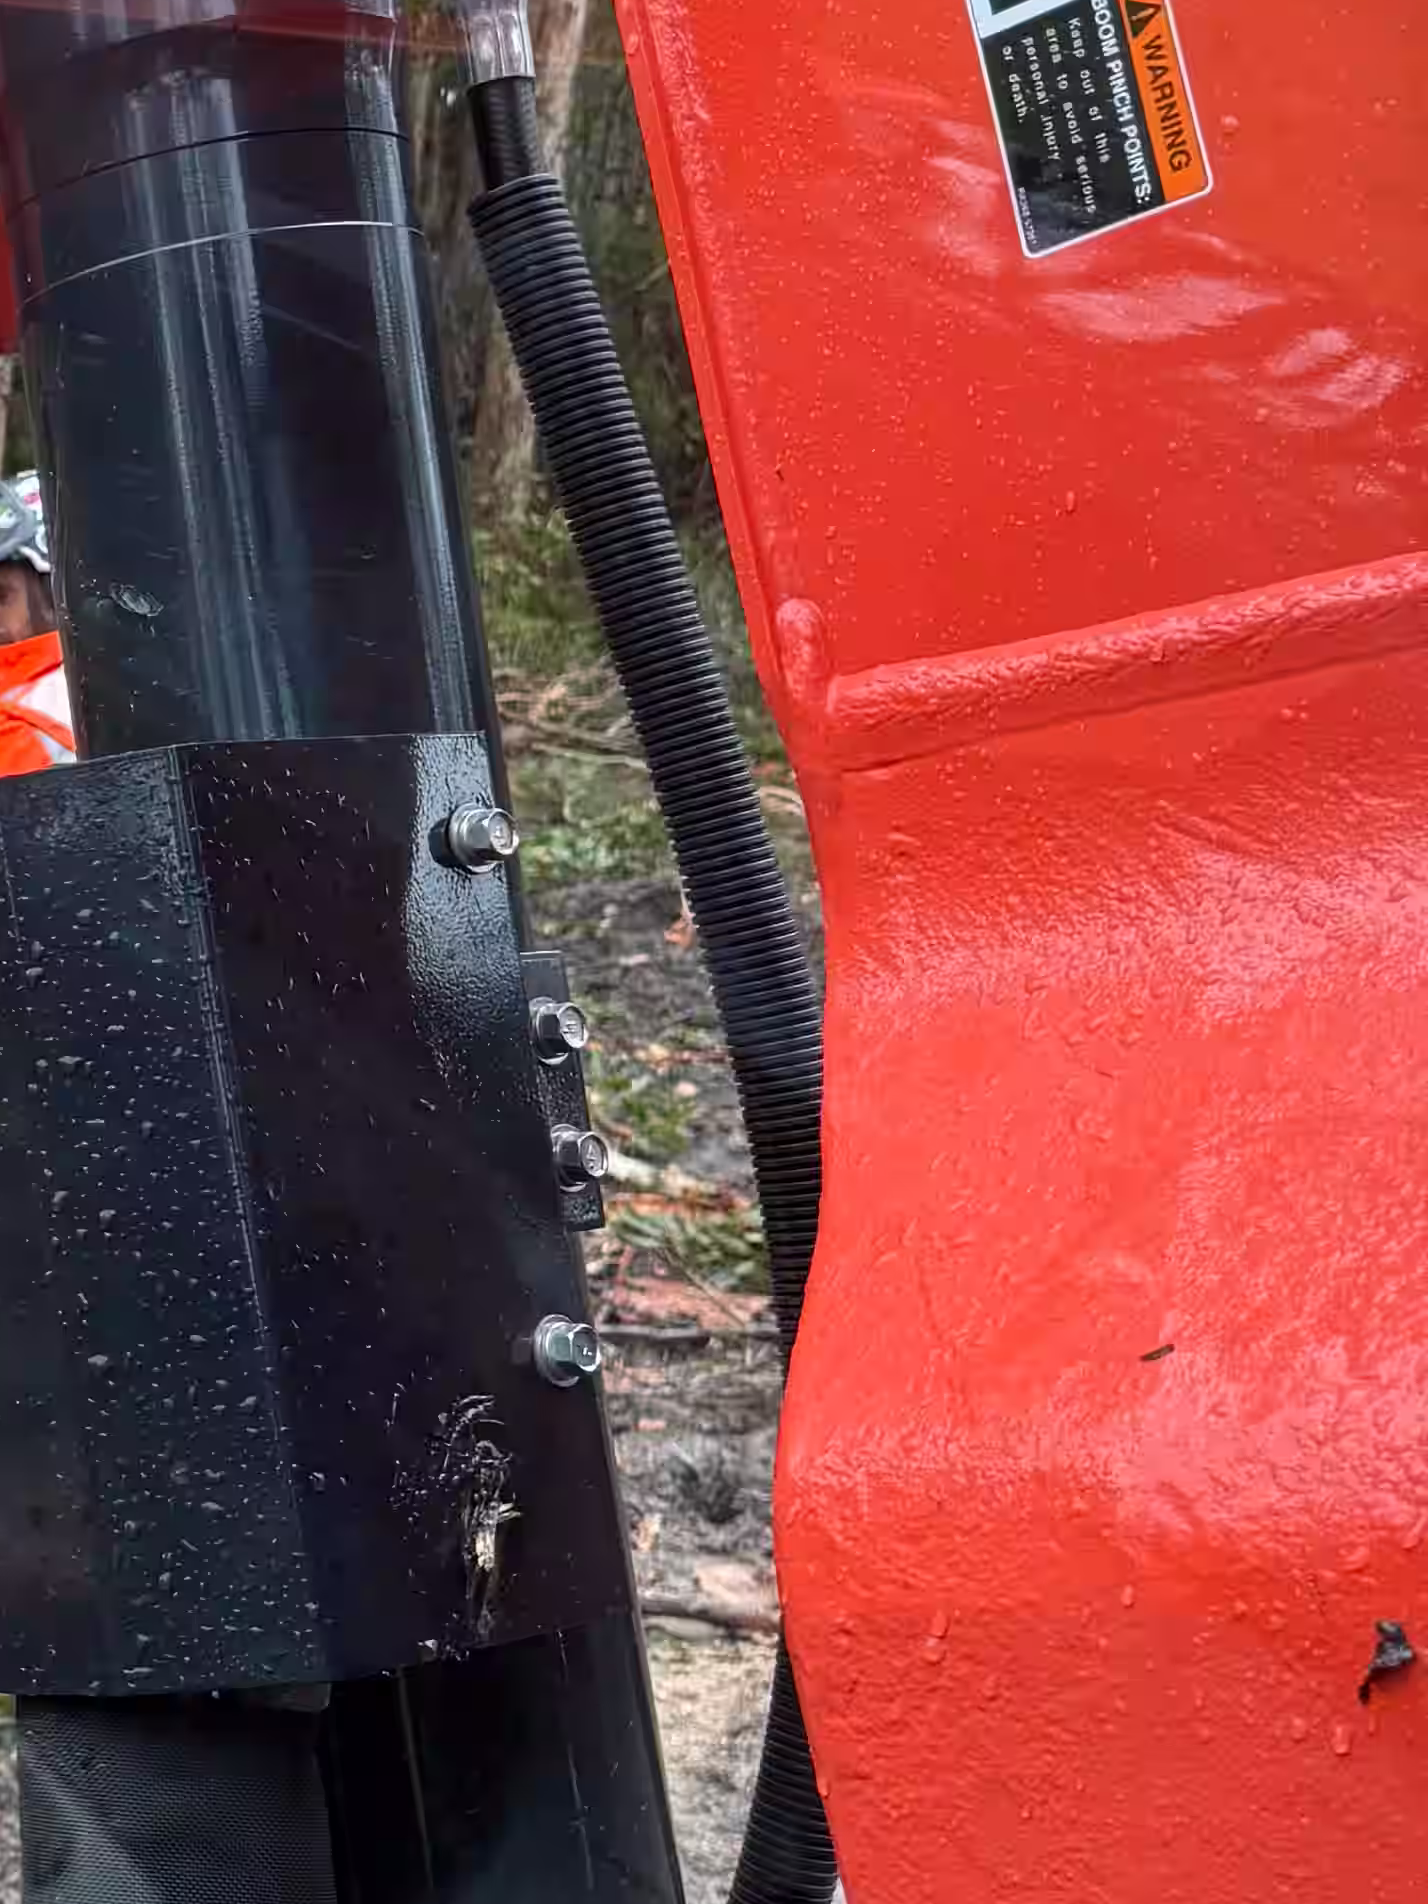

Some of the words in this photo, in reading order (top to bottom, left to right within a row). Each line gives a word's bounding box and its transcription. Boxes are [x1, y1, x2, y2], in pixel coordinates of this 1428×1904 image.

[1002, 45, 1013, 62] or
[1066, 17, 1086, 59] Keep
[1022, 36, 1047, 106] personal
[1040, 116, 1059, 162] injury
[1079, 69, 1094, 95] out
[1140, 34, 1190, 172] WARNING
[1045, 26, 1062, 64] area
[1056, 74, 1067, 90] to
[1062, 101, 1080, 145] avoid
[1075, 155, 1095, 213] serious
[1088, 105, 1101, 122] of
[1106, 59, 1132, 121] PINCH
[1121, 124, 1152, 204] POINTS:
[1094, 133, 1109, 163] this
